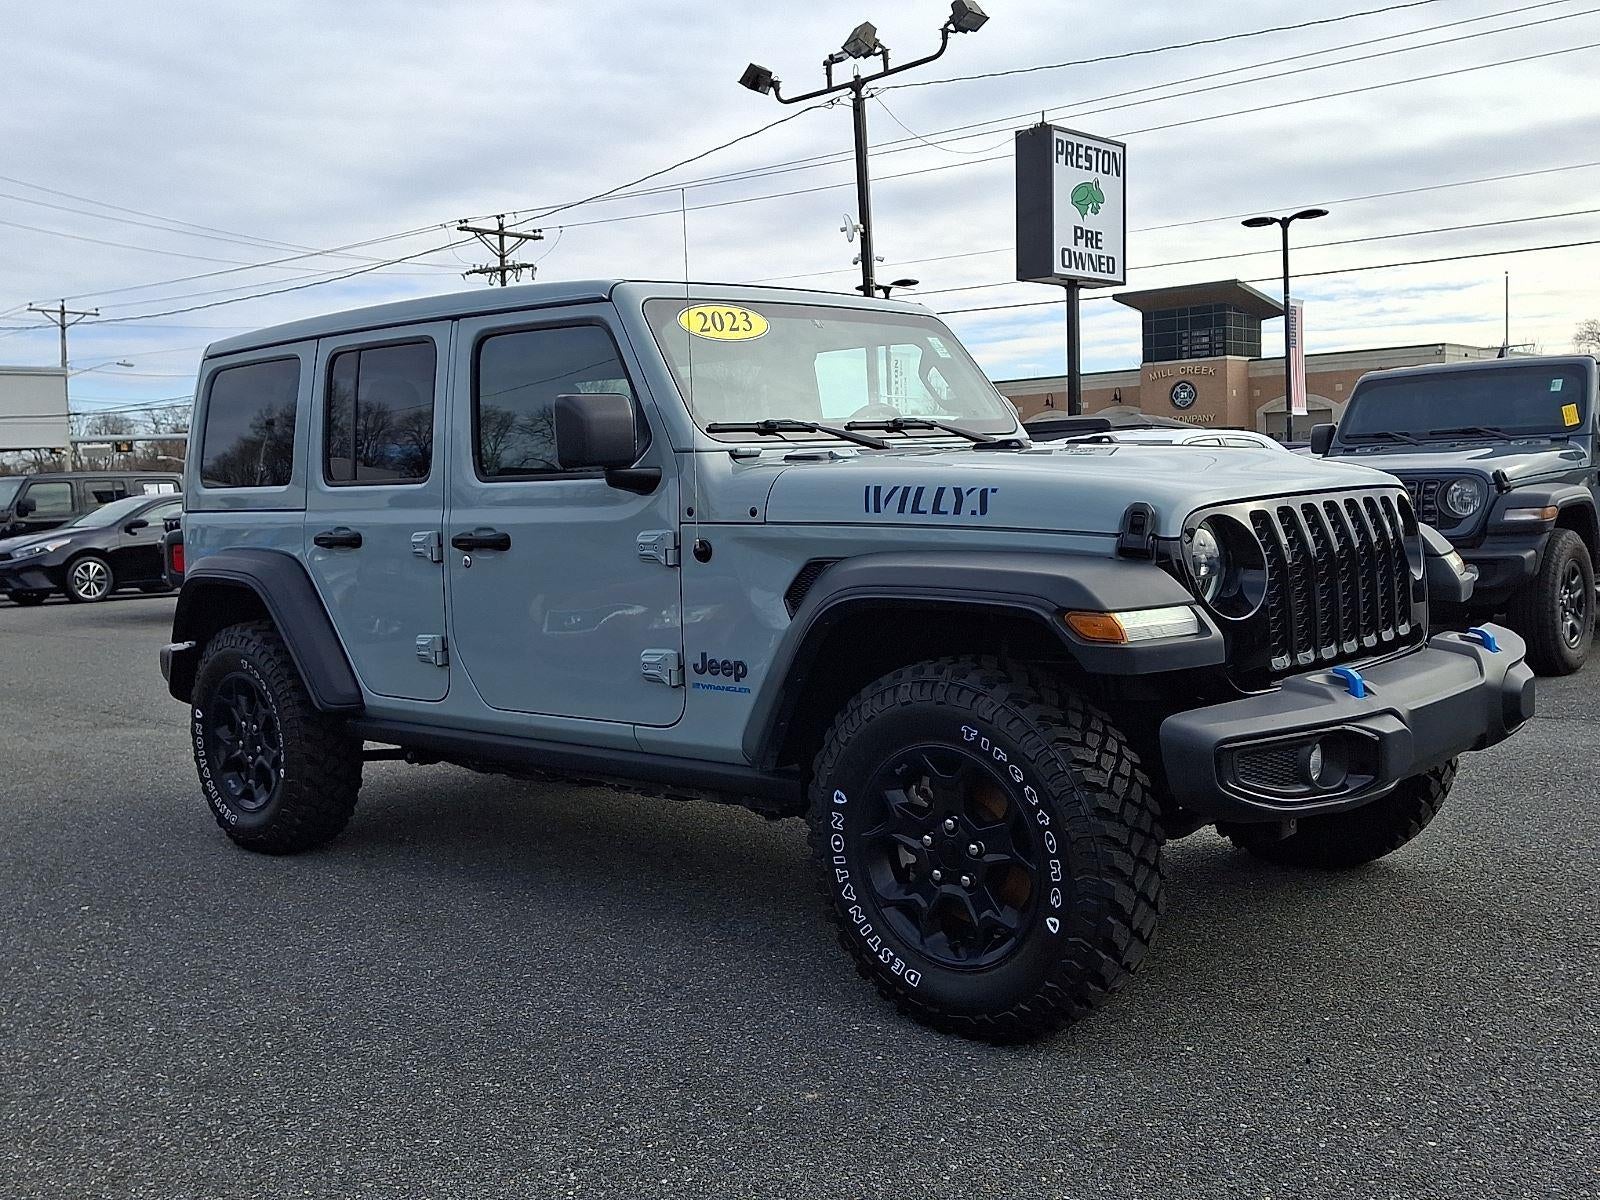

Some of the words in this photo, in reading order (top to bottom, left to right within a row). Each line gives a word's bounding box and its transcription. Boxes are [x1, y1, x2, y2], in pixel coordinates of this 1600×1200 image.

[1055, 138, 1121, 177] PRESTON
[1073, 225, 1103, 250] PRE
[1061, 247, 1116, 275] OWNED
[696, 311, 753, 333] 2023
[1149, 368, 1174, 381] MILL
[1179, 365, 1216, 376] CREEK
[864, 485, 999, 516] WILLYS
[693, 652, 747, 682] Jeep
[831, 811, 921, 987] DESTINATION
